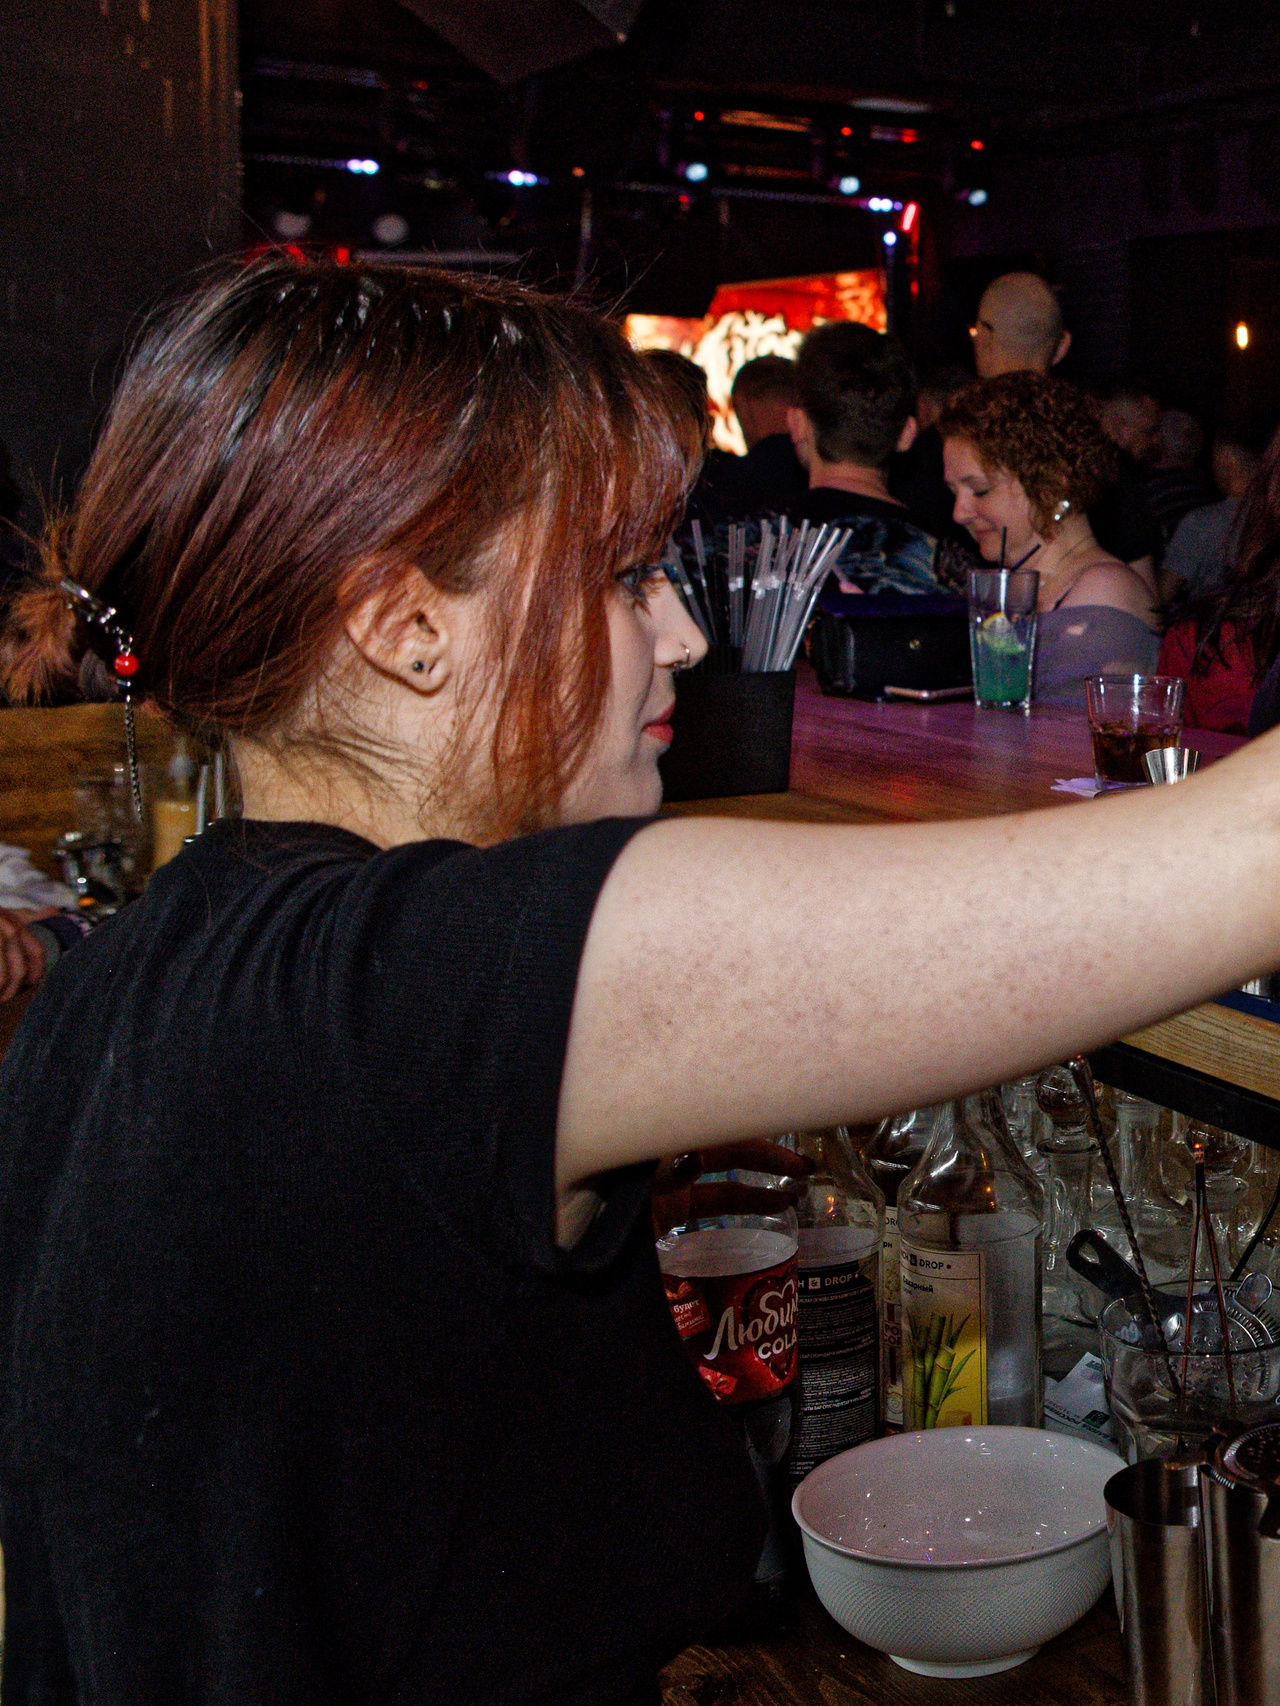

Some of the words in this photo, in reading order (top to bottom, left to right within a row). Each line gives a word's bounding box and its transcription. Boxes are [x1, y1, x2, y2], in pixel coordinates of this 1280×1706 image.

[920, 1259, 944, 1270] DROP
[825, 1273, 853, 1287] DROP
[673, 1299, 700, 1313] будет
[758, 1328, 797, 1359] COLA
